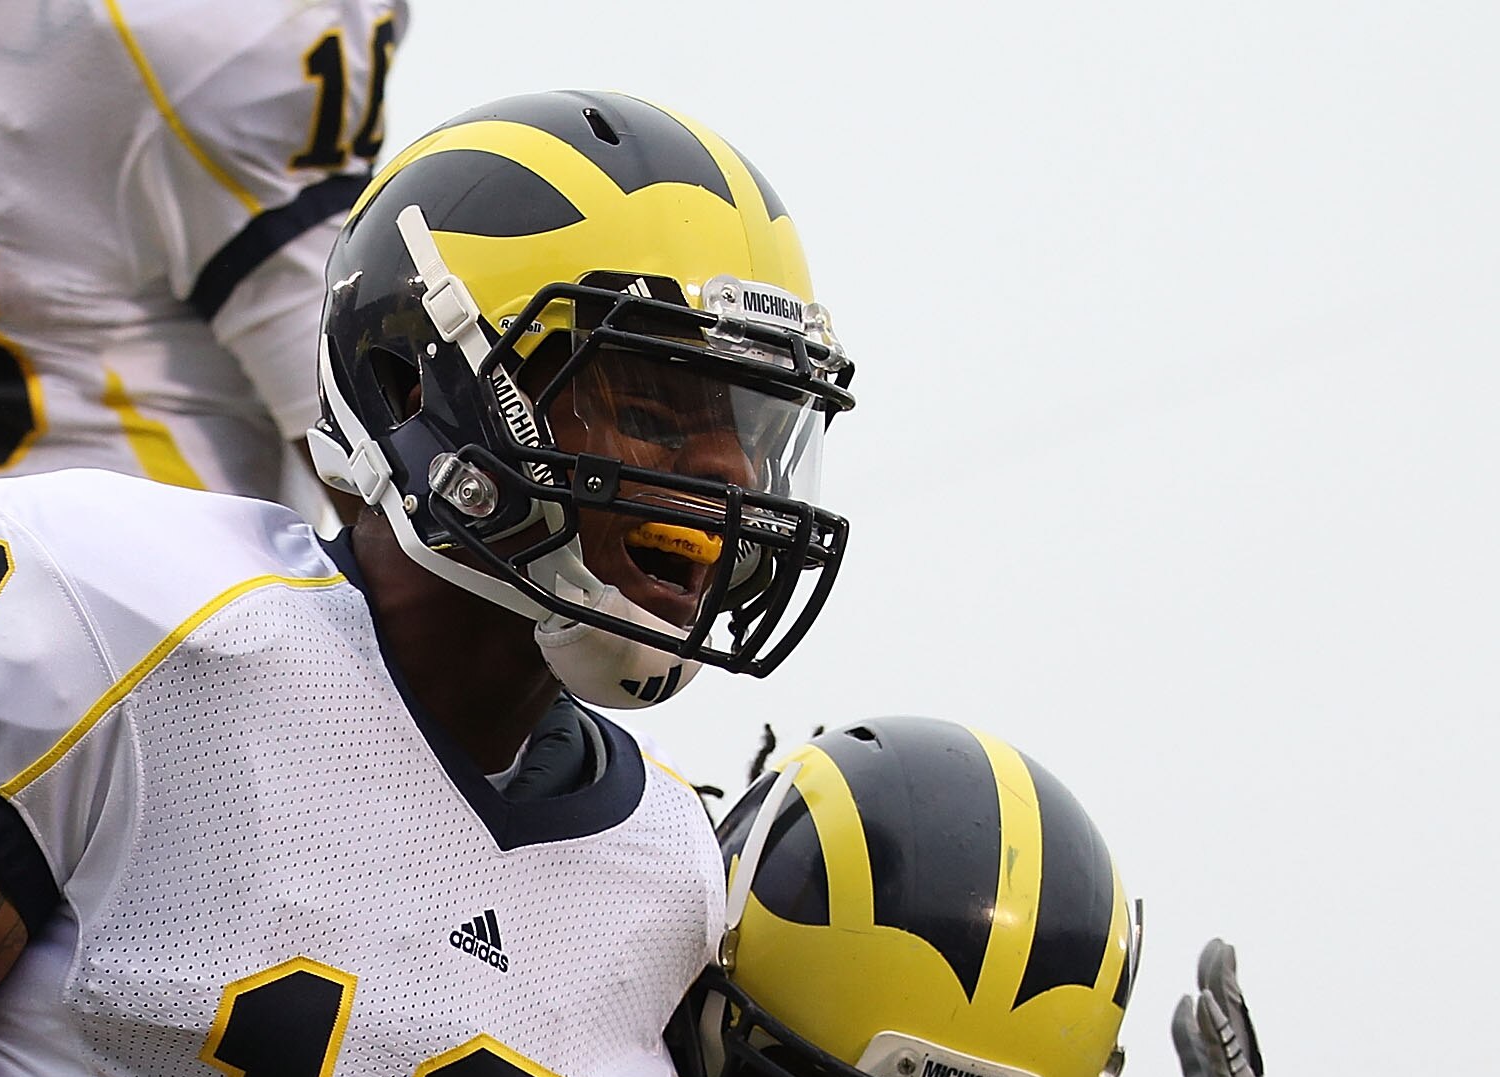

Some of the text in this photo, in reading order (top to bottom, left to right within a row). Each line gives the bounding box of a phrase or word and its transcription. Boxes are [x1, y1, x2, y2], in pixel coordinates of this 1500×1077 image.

[742, 291, 803, 323] MICHIGAN
[500, 319, 542, 334] Rell
[449, 930, 509, 973] adidas
